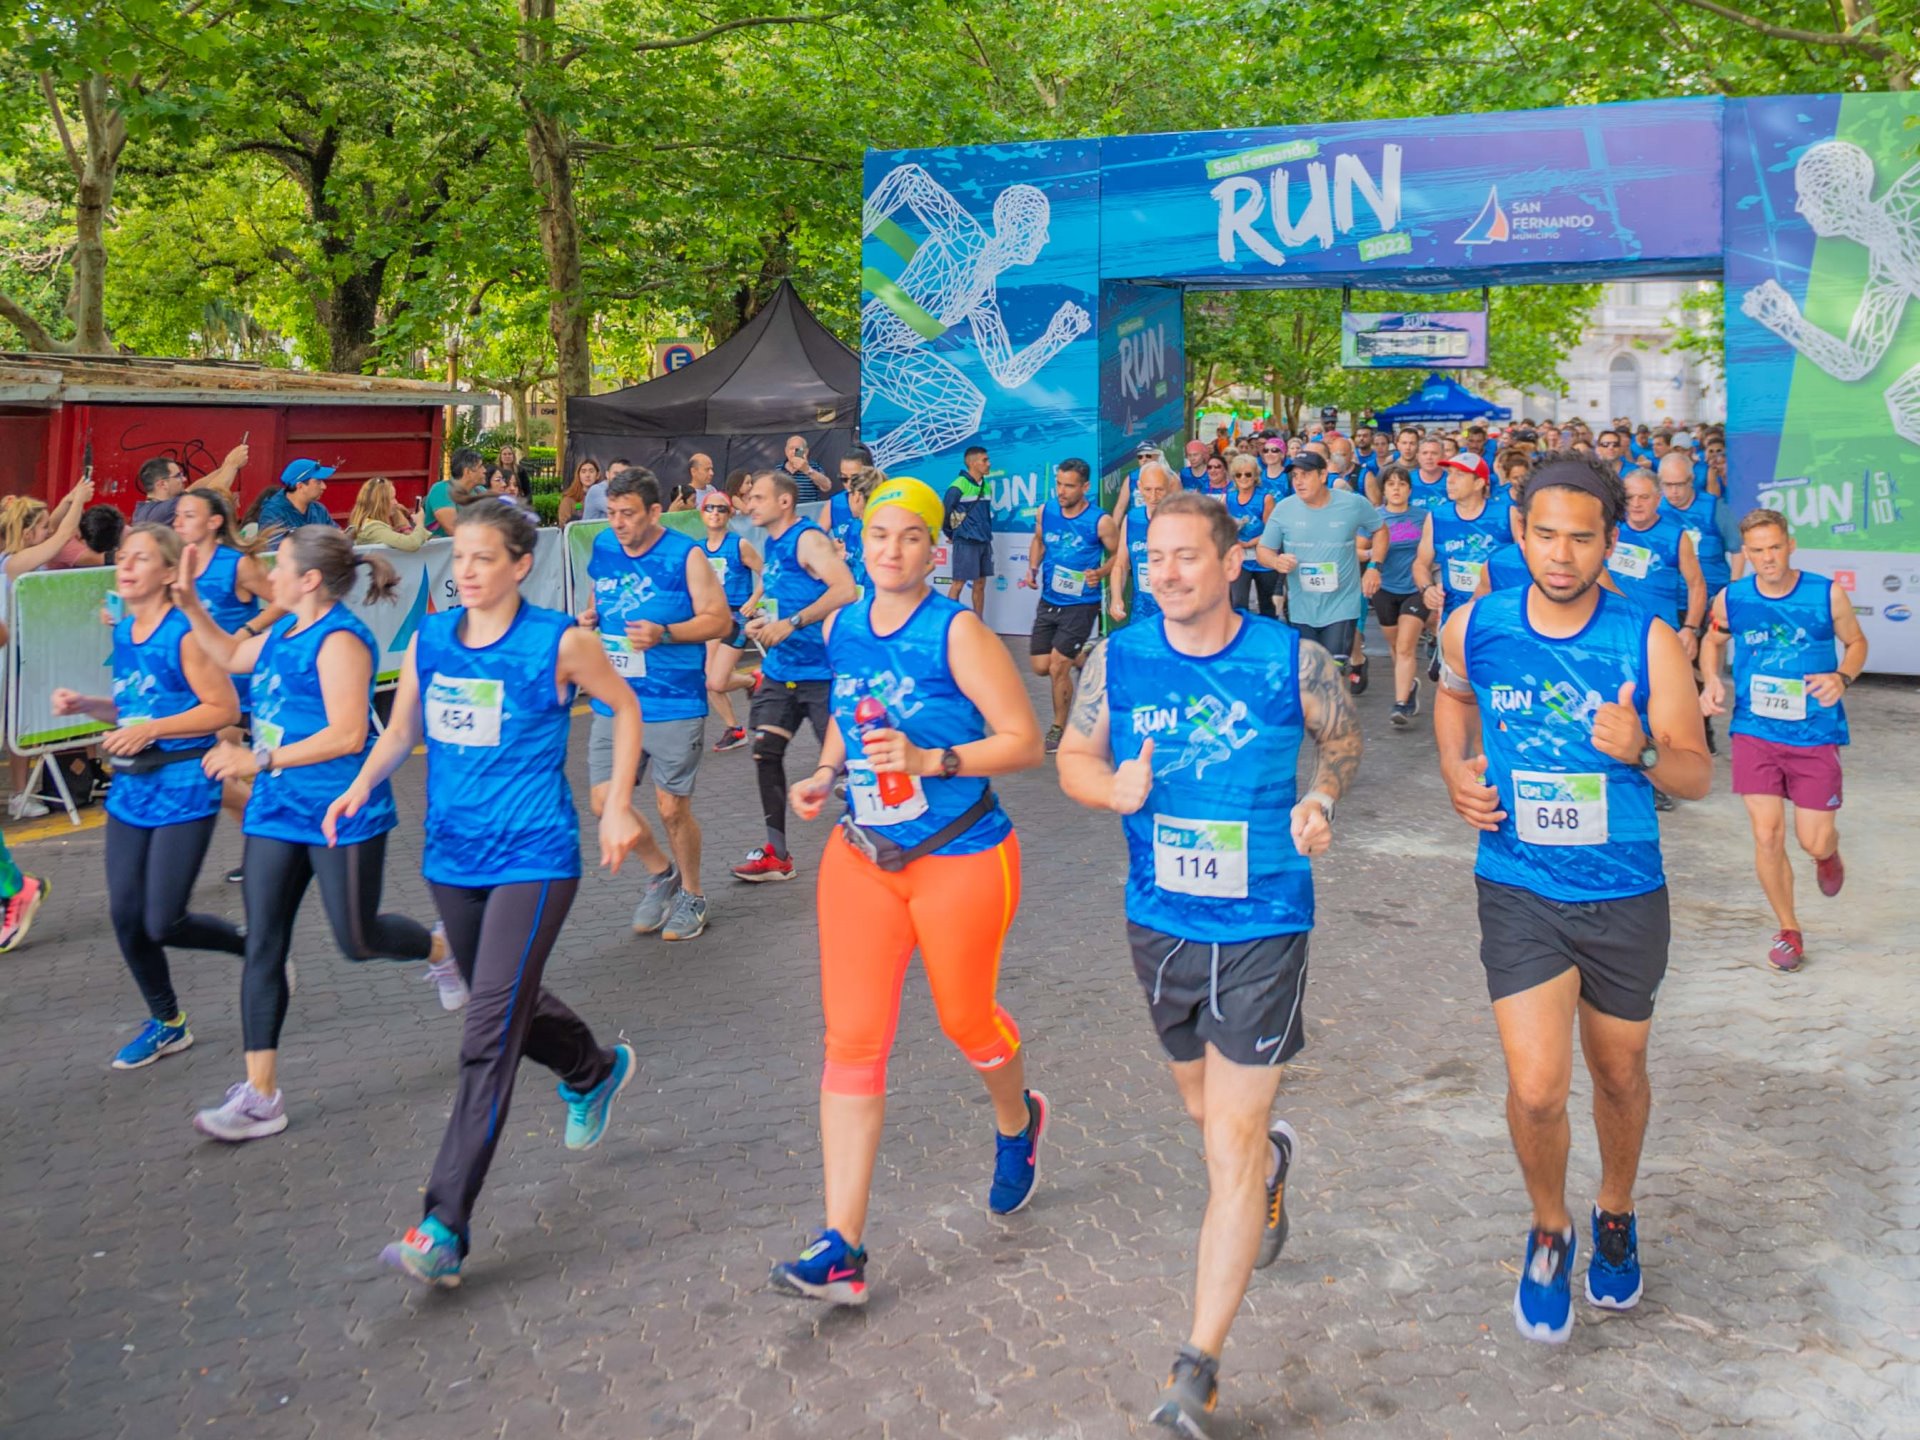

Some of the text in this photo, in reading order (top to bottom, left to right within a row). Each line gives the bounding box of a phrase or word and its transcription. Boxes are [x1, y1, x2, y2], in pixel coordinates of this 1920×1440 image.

[1213, 143, 1311, 175] San Fernando
[1210, 143, 1402, 266] RUN
[1512, 201, 1541, 214] SAN
[1513, 215, 1594, 229] FERNANDO
[1366, 236, 1406, 257] 2022
[1512, 232, 1560, 240] MUNICIPIO
[671, 353, 687, 370] E
[1119, 323, 1164, 400] RUN
[991, 472, 1037, 517] UN
[1756, 481, 1853, 534] RUN
[1309, 577, 1325, 586] 461
[1491, 690, 1532, 713] RUN
[1764, 697, 1788, 709] 778
[440, 709, 475, 731] 454
[1132, 707, 1177, 735] RUN
[1537, 807, 1579, 829] 648
[1176, 855, 1218, 879] 114
